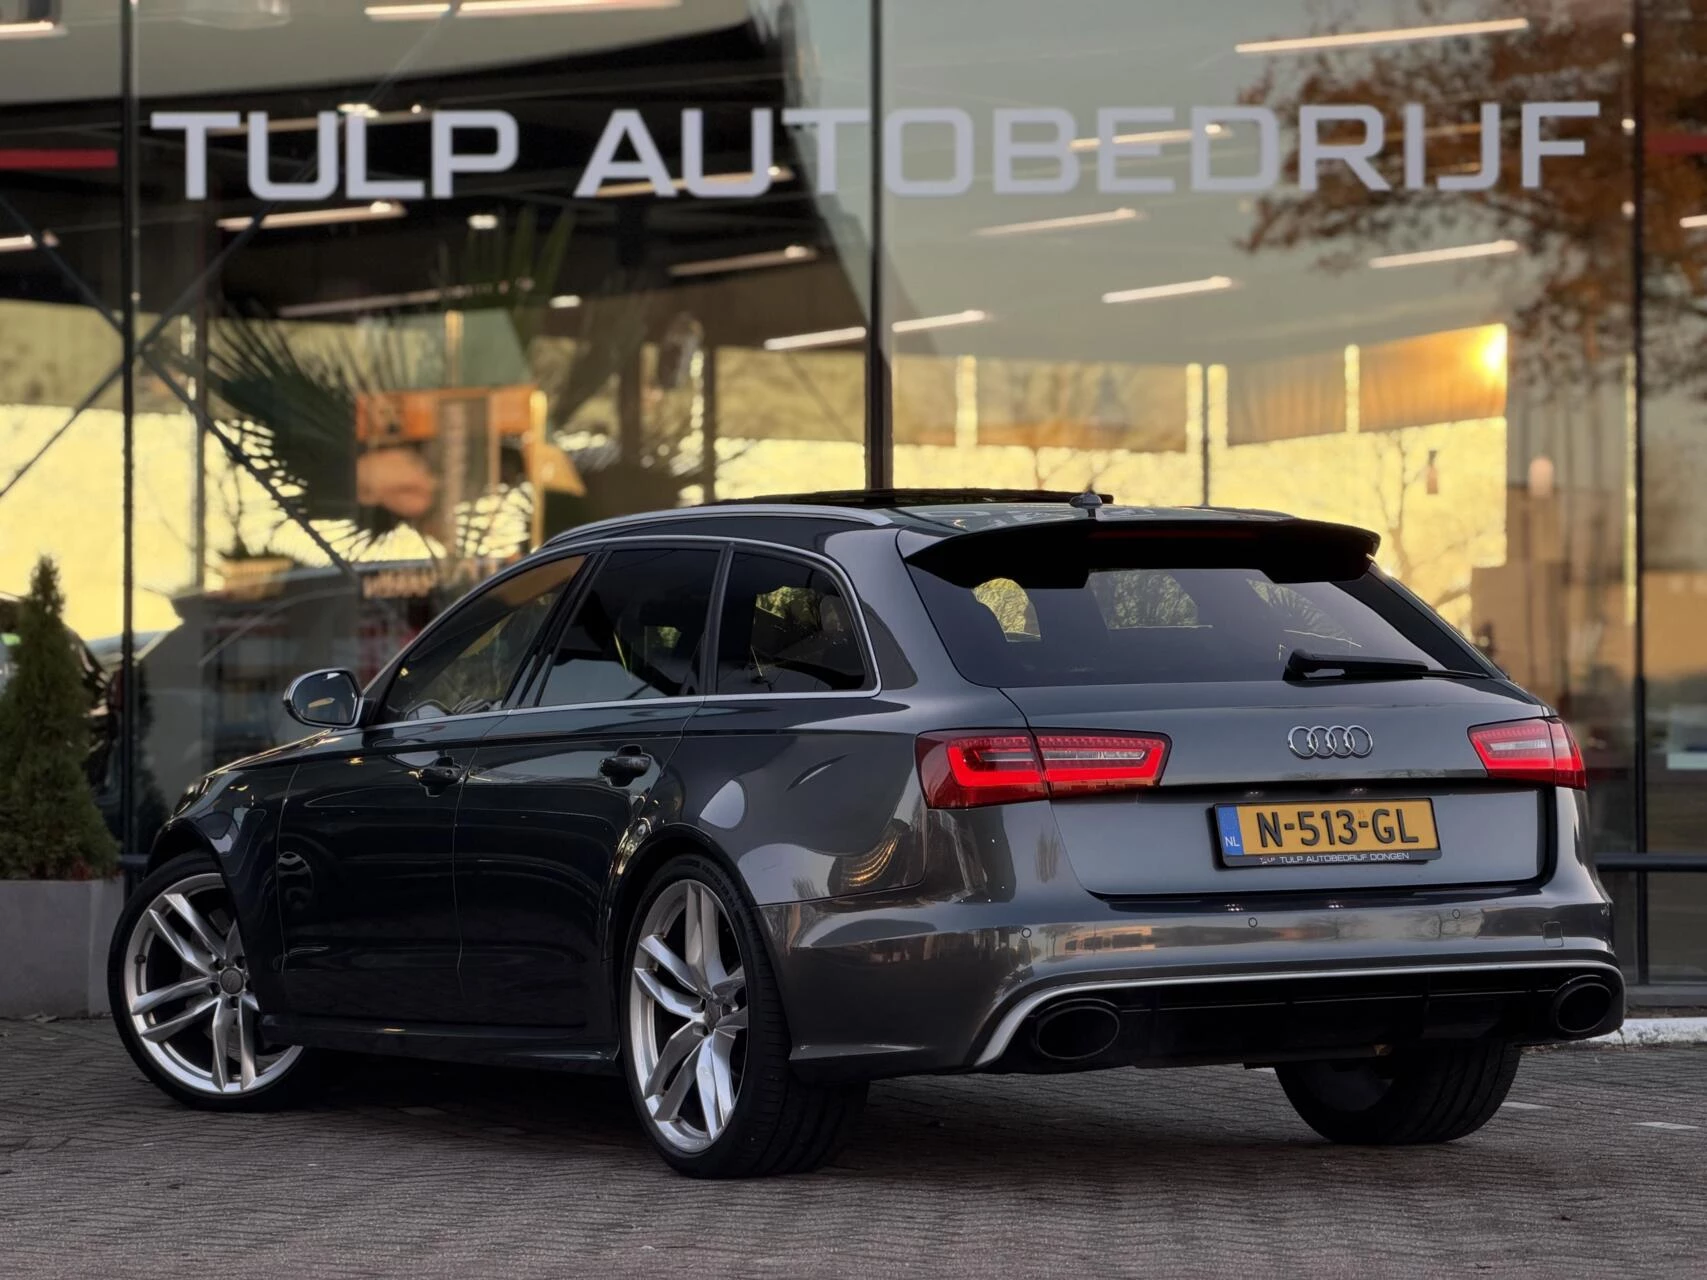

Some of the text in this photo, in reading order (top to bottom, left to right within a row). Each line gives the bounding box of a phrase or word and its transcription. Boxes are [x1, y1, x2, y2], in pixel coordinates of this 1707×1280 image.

[151, 100, 1601, 203] TULP AUTOBEDRIJF
[1256, 808, 1420, 848] N-513-GL
[1225, 836, 1240, 848] NL
[1279, 855, 1304, 864] TULP
[1305, 853, 1368, 864] AUTOBEDRIJF
[1370, 852, 1411, 861] DONGEN
